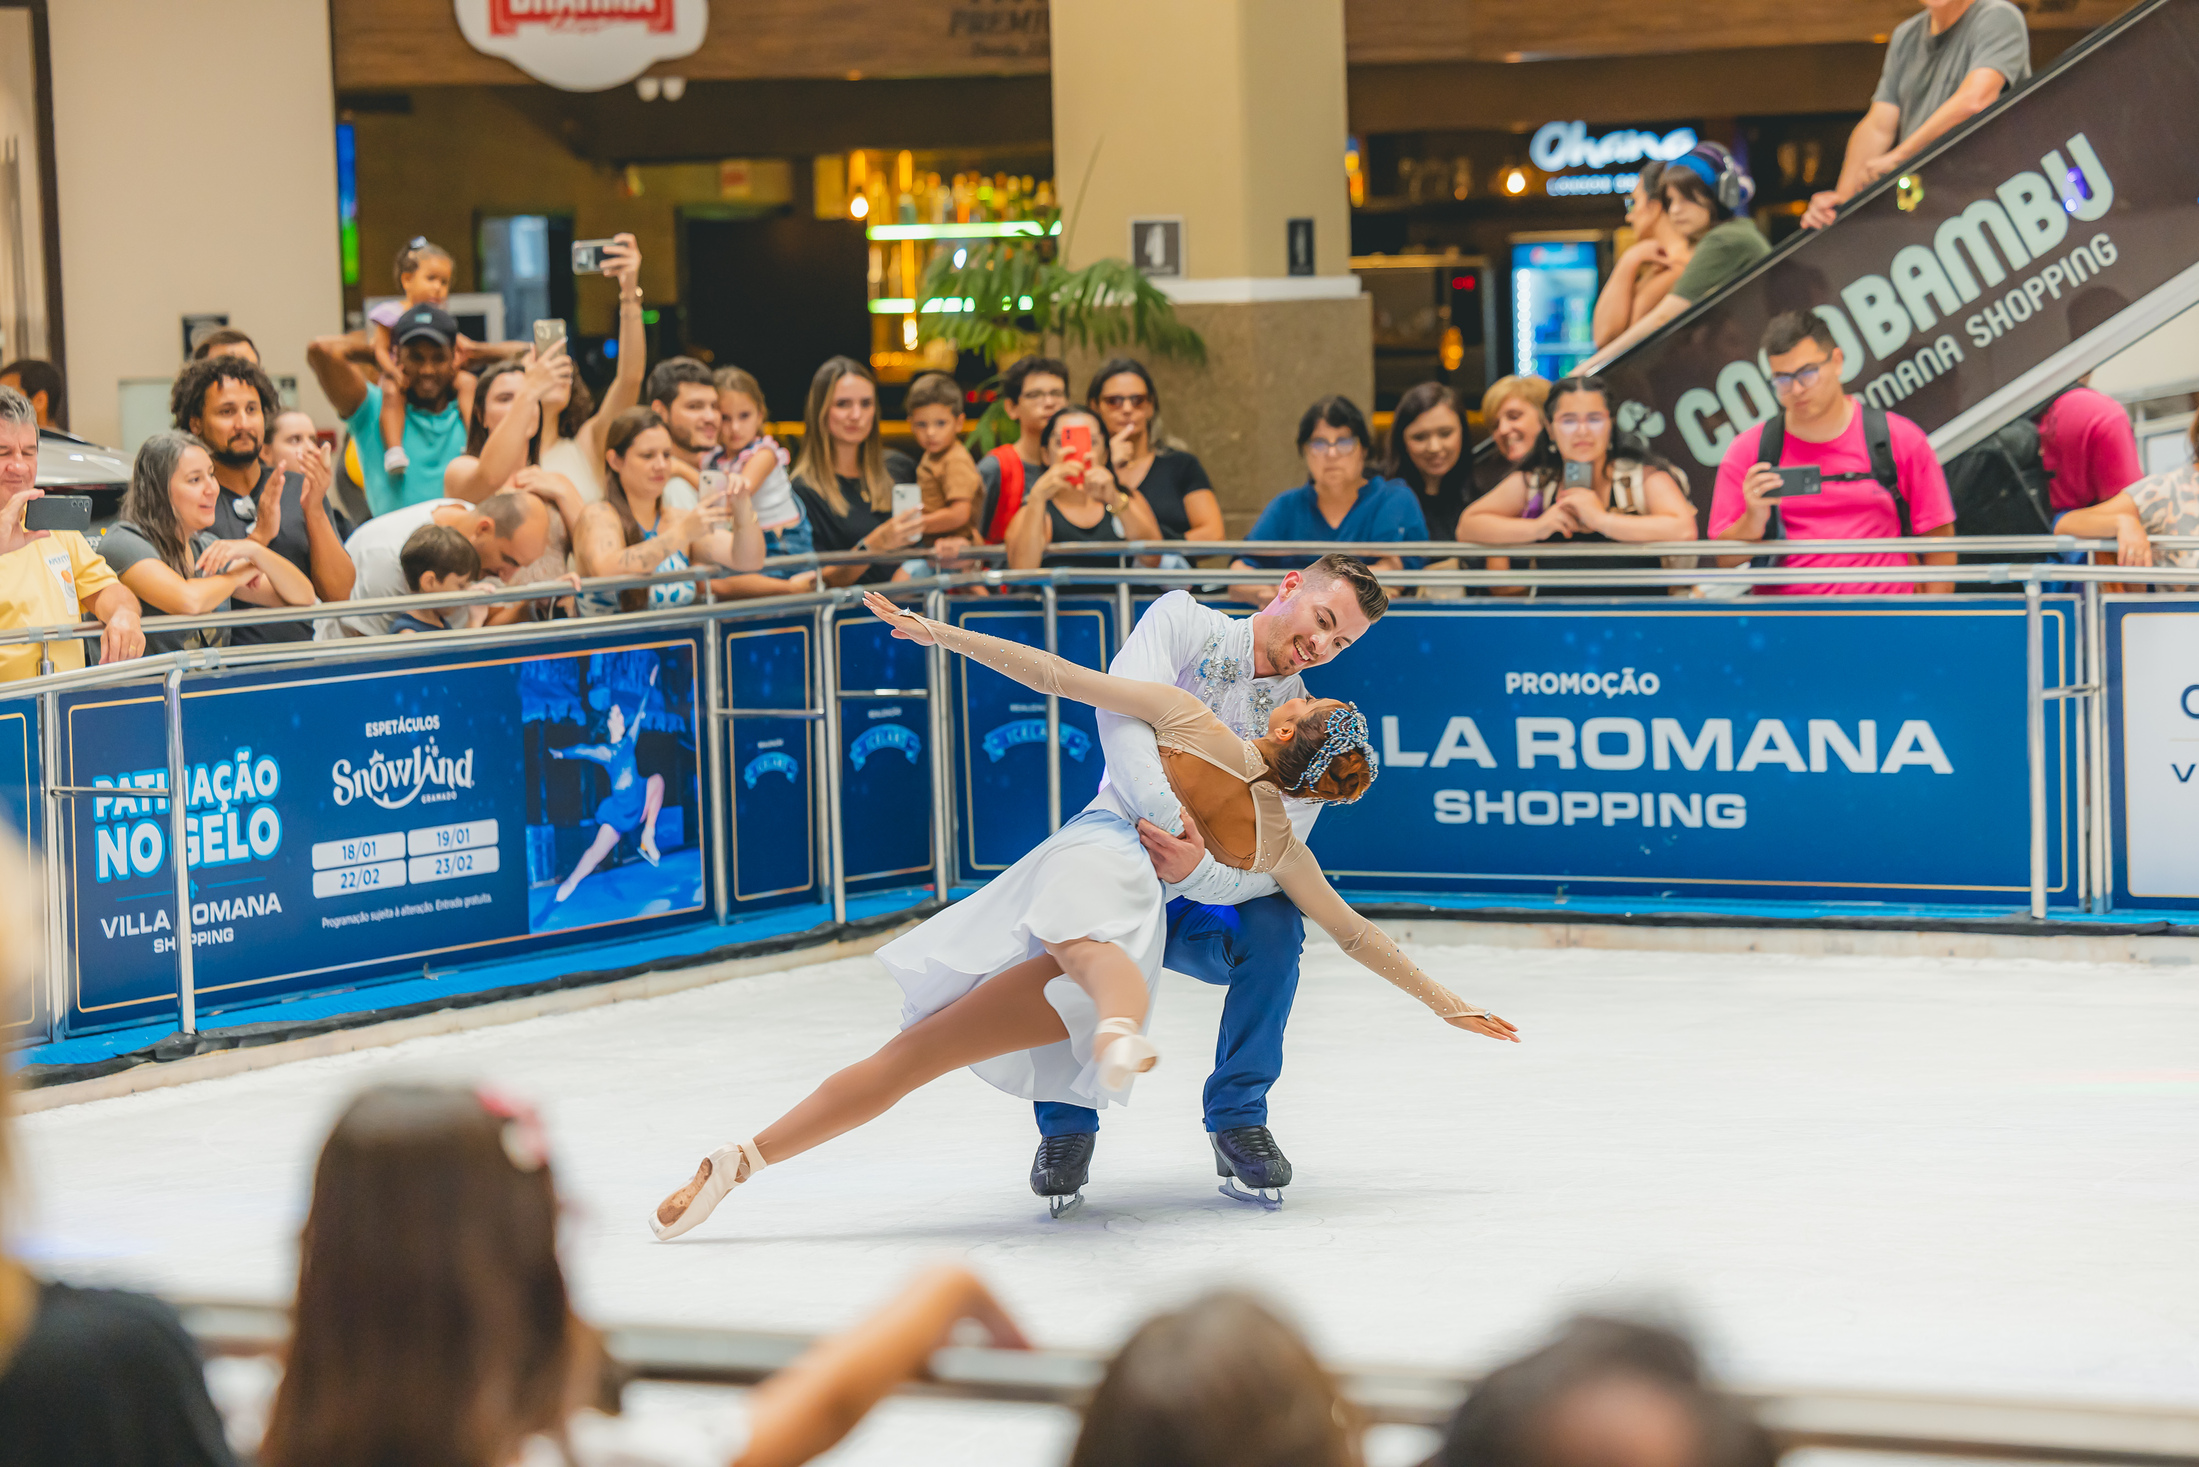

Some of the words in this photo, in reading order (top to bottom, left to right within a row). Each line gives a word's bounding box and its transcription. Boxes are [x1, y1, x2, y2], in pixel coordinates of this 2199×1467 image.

[1965, 233, 2118, 348] SHOPPING
[1505, 667, 1660, 699] PROMOÇÃO
[365, 715, 440, 737] ESPETÁCULOS
[1515, 716, 1954, 774] ROMANA
[1433, 789, 1747, 829] SHOPPING
[97, 822, 163, 879] NO
[342, 841, 376, 863] 18/01
[436, 827, 470, 849] 19/01
[340, 868, 380, 890] 22/02
[435, 854, 473, 876] 23/02
[101, 909, 171, 939] VILLA
[191, 892, 282, 926] OMANA
[154, 927, 234, 954] SHPPING
